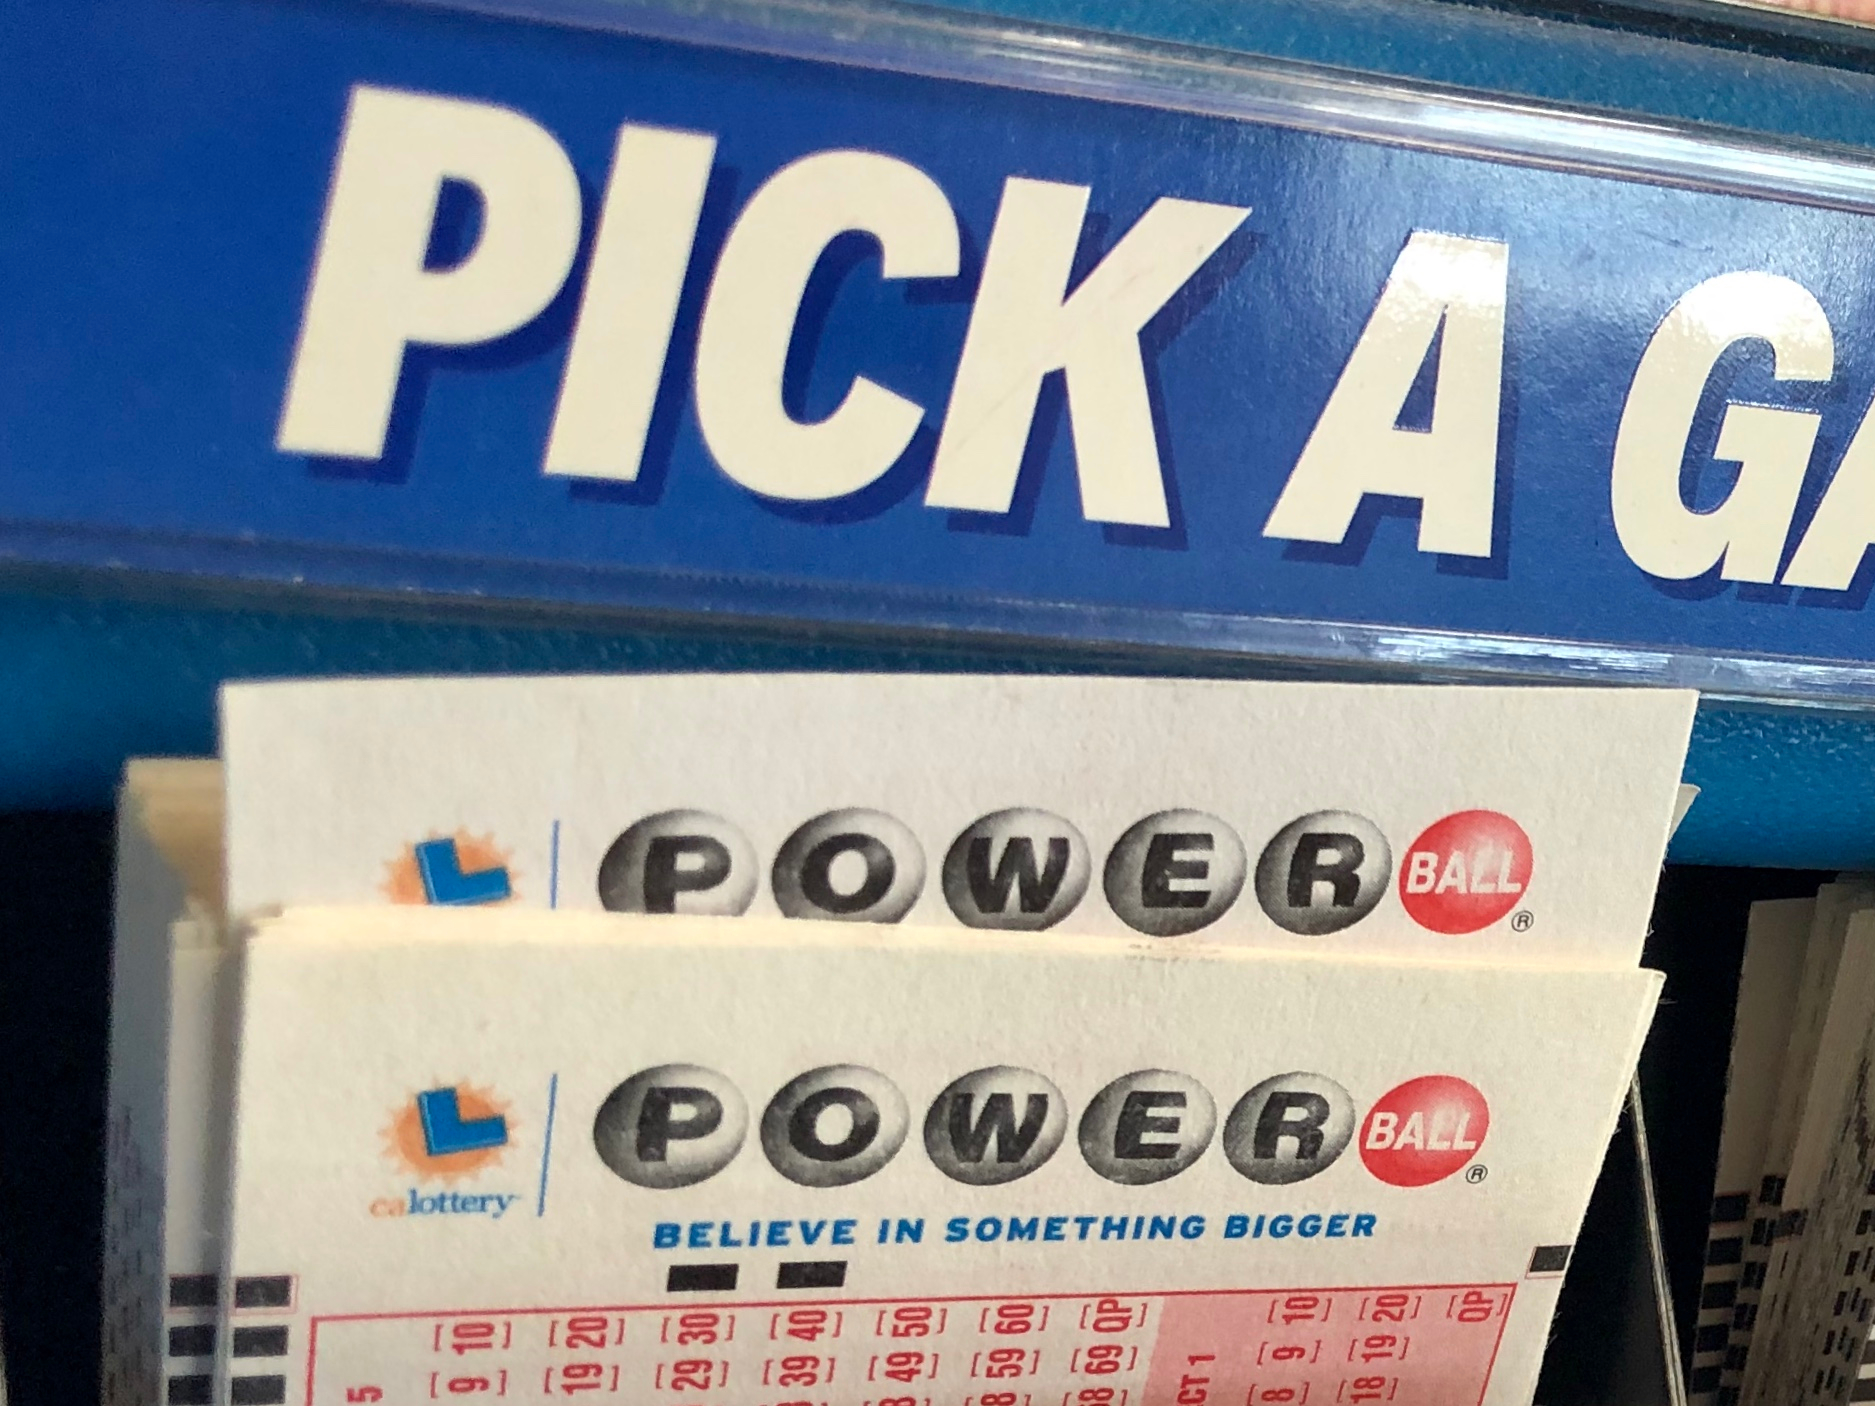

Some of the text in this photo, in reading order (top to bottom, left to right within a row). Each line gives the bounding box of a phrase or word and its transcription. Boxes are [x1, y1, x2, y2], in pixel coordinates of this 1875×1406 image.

[273, 85, 1252, 530] PICK
[1264, 230, 1511, 560] A
[370, 1188, 515, 1219] calottery
[653, 1212, 1379, 1250] BELIEVE IN SOMETHING BIGGER
[347, 1386, 381, 1403] 5
